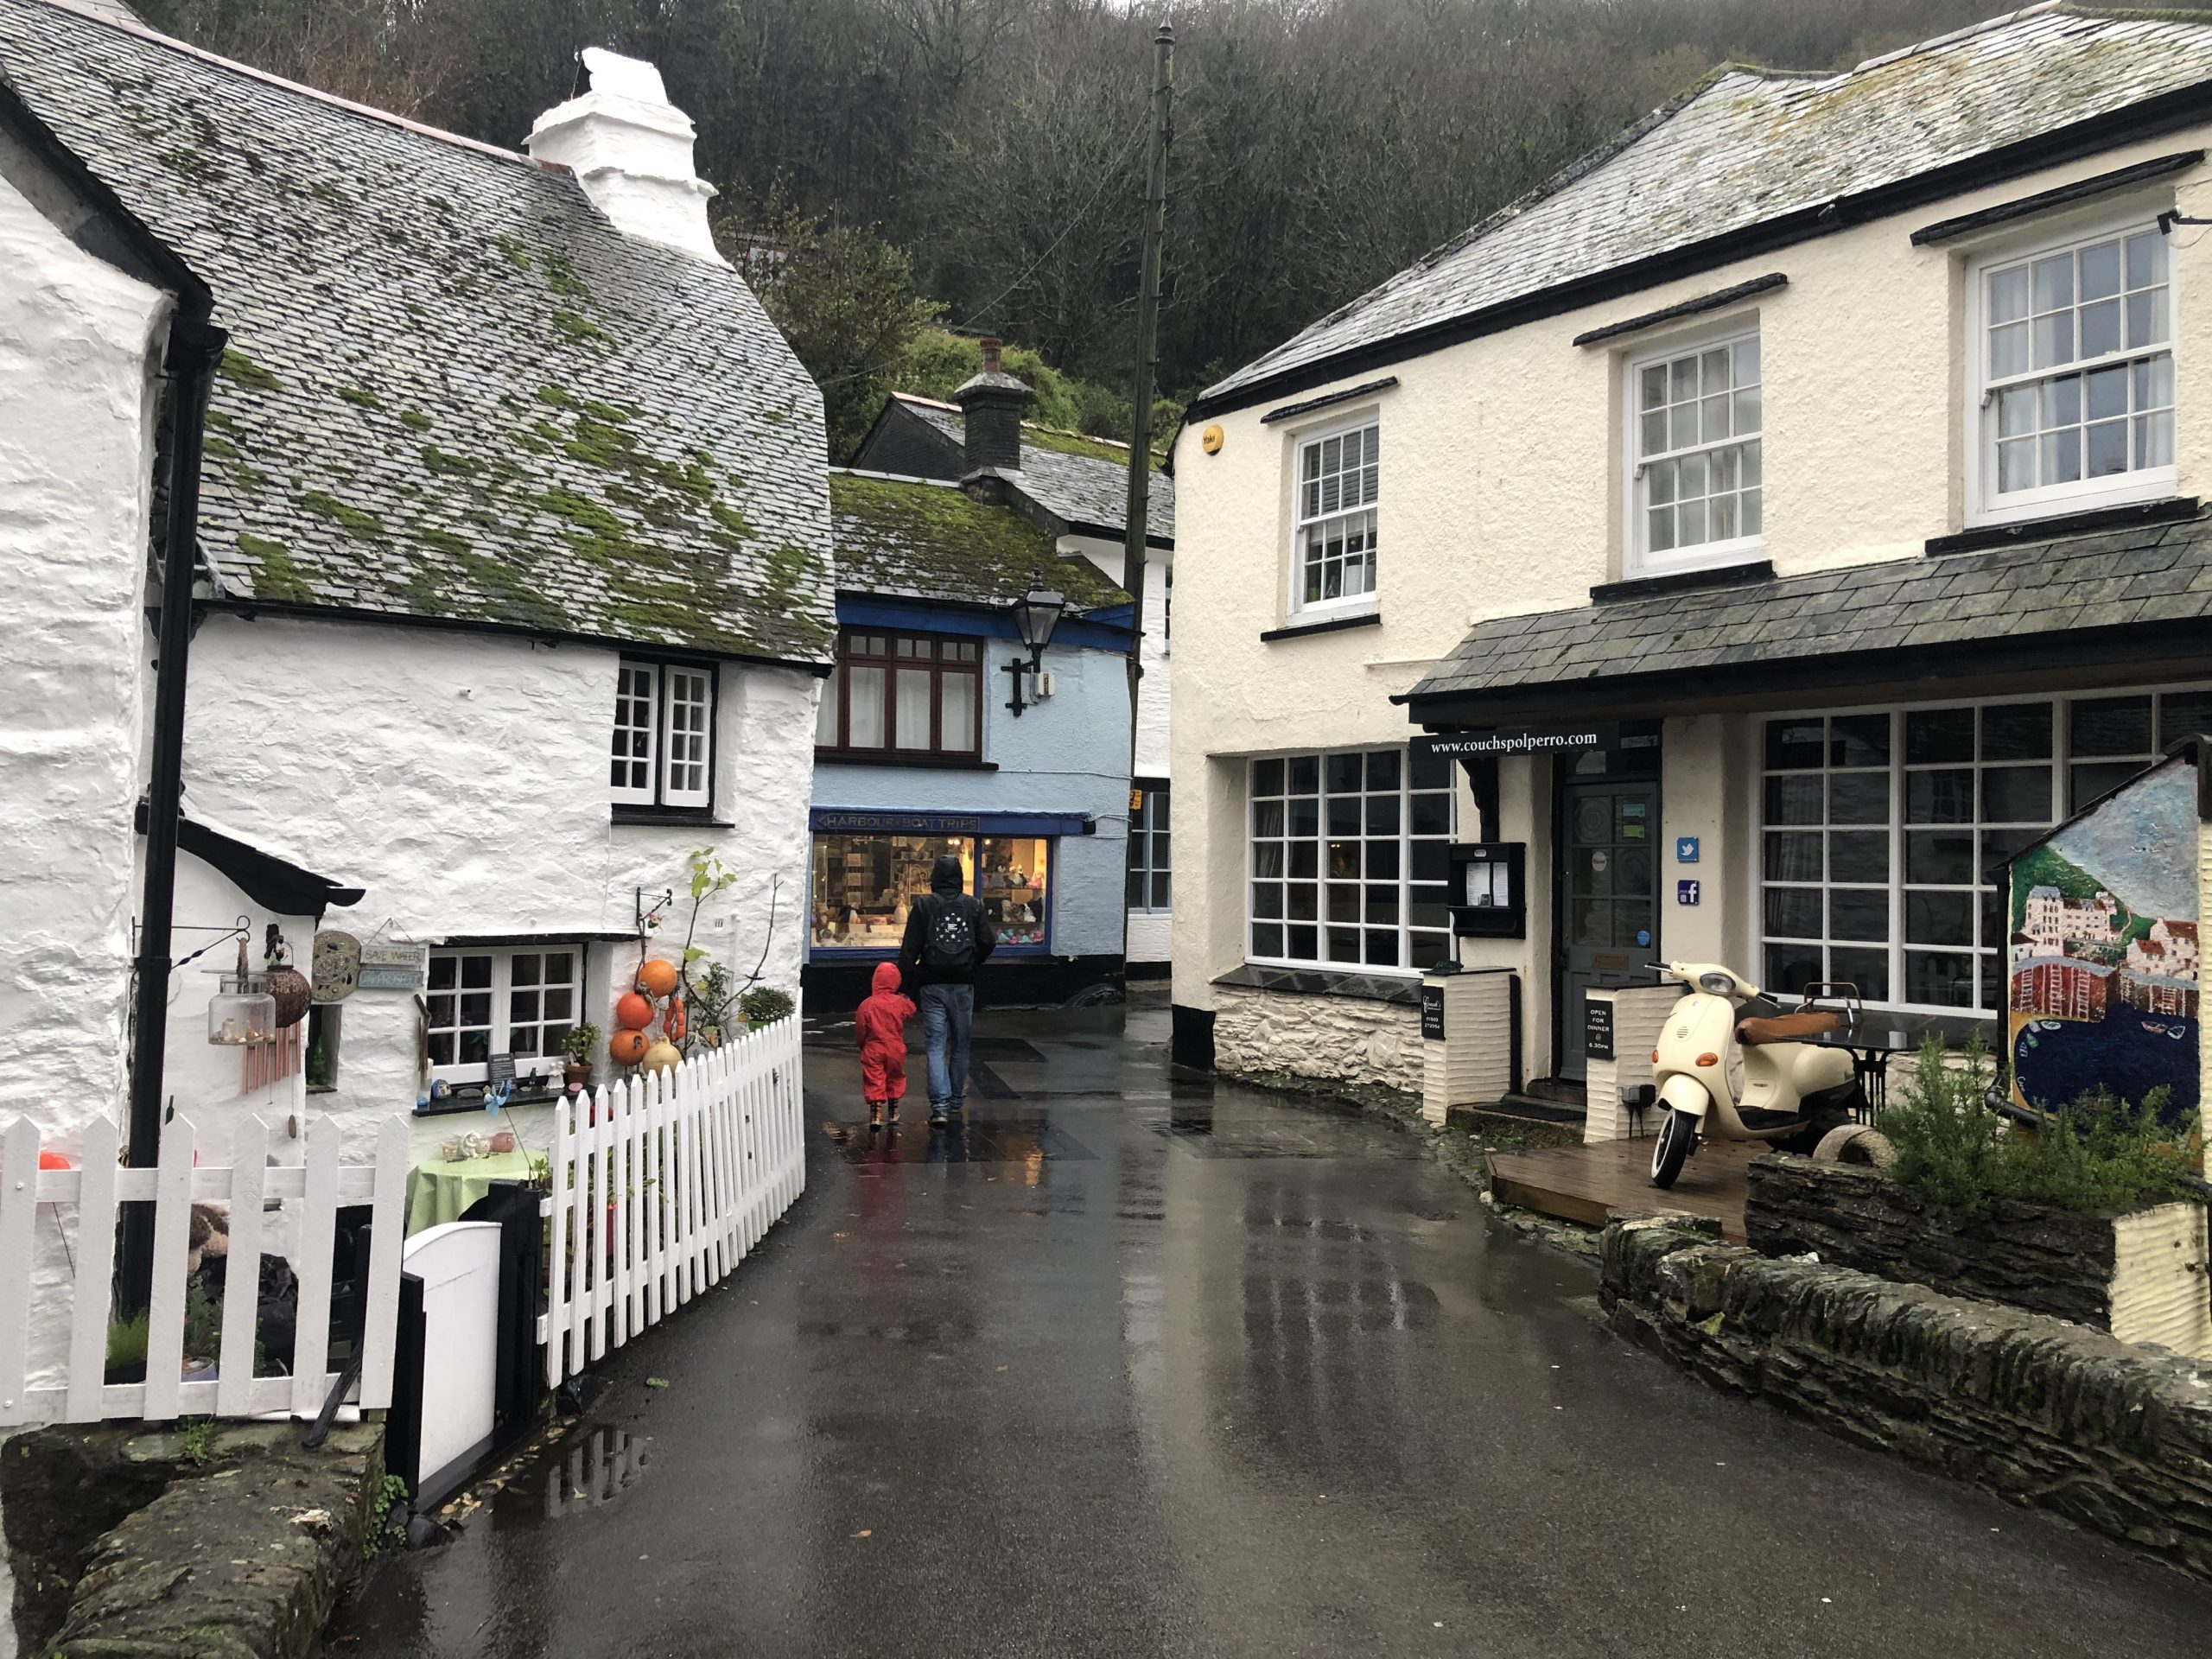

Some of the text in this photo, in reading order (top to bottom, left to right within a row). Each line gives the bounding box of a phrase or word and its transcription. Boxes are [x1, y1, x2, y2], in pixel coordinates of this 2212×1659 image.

[1203, 434, 1215, 445] Yale
[1431, 733, 1597, 753] www.couchspolperro.com
[827, 817, 977, 830] HARBOUR BOAT TRIPS
[365, 950, 422, 962] SAVE WATER
